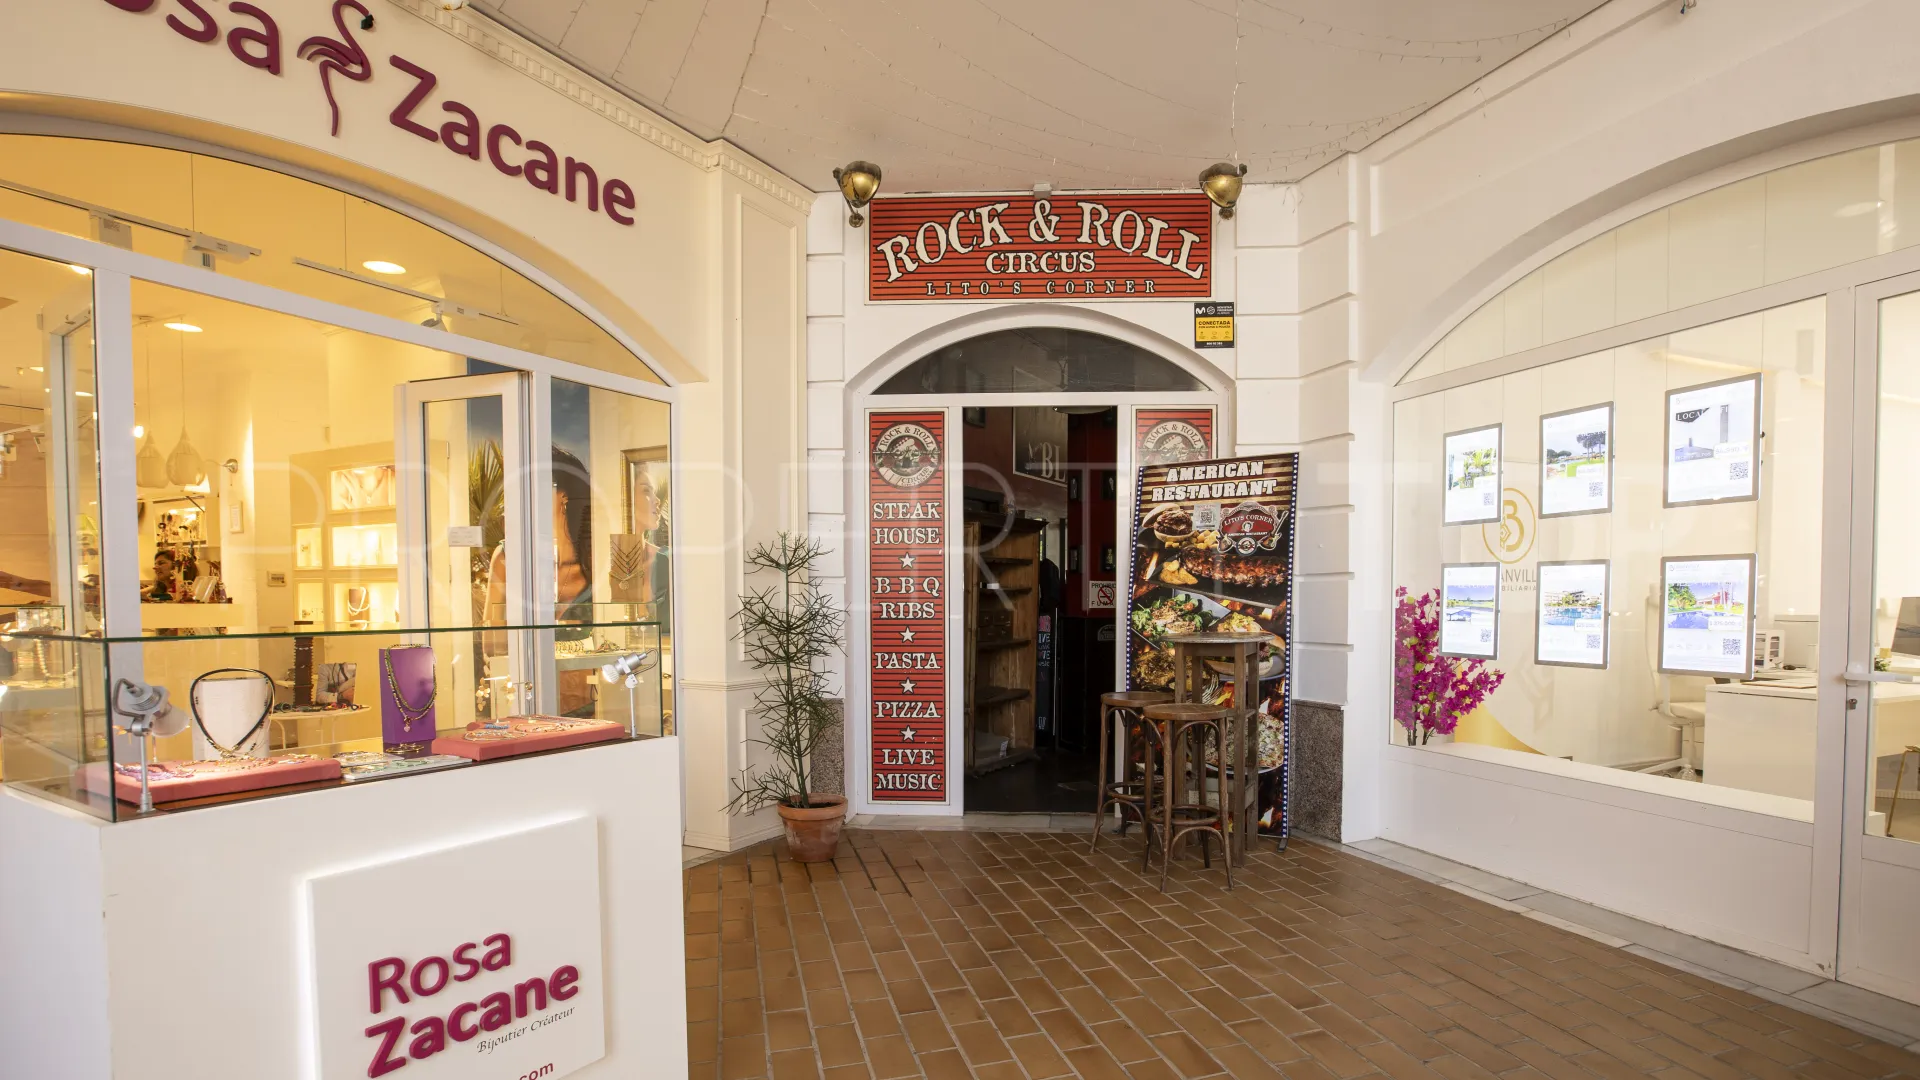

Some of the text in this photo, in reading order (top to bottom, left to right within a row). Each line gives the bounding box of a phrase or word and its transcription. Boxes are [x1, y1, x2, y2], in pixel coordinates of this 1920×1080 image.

[99, 0, 636, 225] sa Zacane
[876, 199, 1206, 283] ROCK & ROLL
[985, 251, 1097, 274] CIRCUS
[927, 279, 1156, 296] LITO'S CORNER
[879, 426, 934, 448] ROCK & ROLL
[1146, 423, 1202, 445] ROCK & ROLL
[1166, 462, 1264, 482] AMERICAN
[1151, 479, 1277, 502] RESTAURANT
[873, 502, 941, 520] STEAK
[1246, 514, 1273, 524] CORNER
[874, 528, 940, 545] HOUSE
[880, 602, 935, 619] RIBS
[875, 652, 941, 669] PASTA
[875, 701, 941, 718] PIZZA
[882, 749, 935, 765] LIVE
[876, 773, 941, 790] MUSIC
[368, 933, 511, 1015] Rosa
[365, 964, 579, 1079] Zacane
[476, 1006, 576, 1055] Bijoutier Créateur
